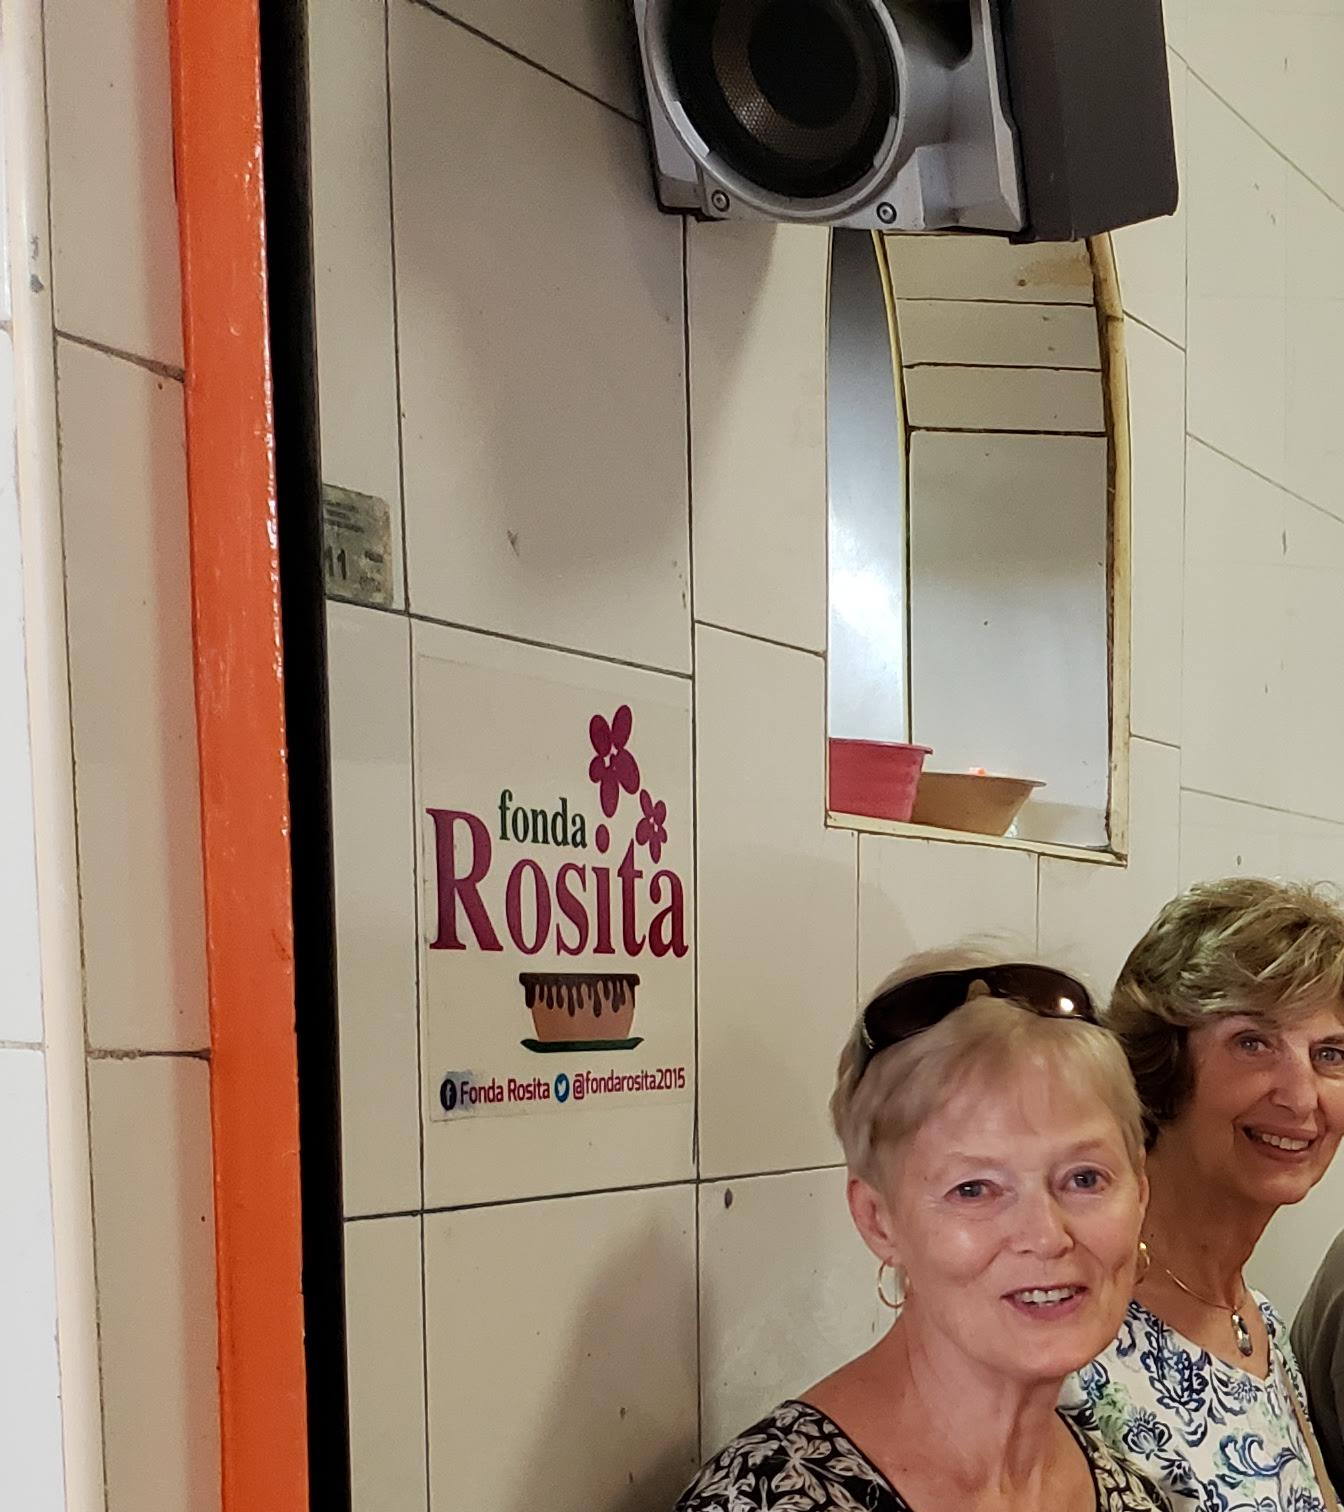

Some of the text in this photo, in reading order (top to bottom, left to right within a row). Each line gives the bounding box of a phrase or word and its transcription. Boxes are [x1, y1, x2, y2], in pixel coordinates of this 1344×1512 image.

[498, 788, 587, 848] fonda
[426, 807, 689, 959] Rosita
[460, 1066, 686, 1105] Fonda Rosita @fondarosita2015
